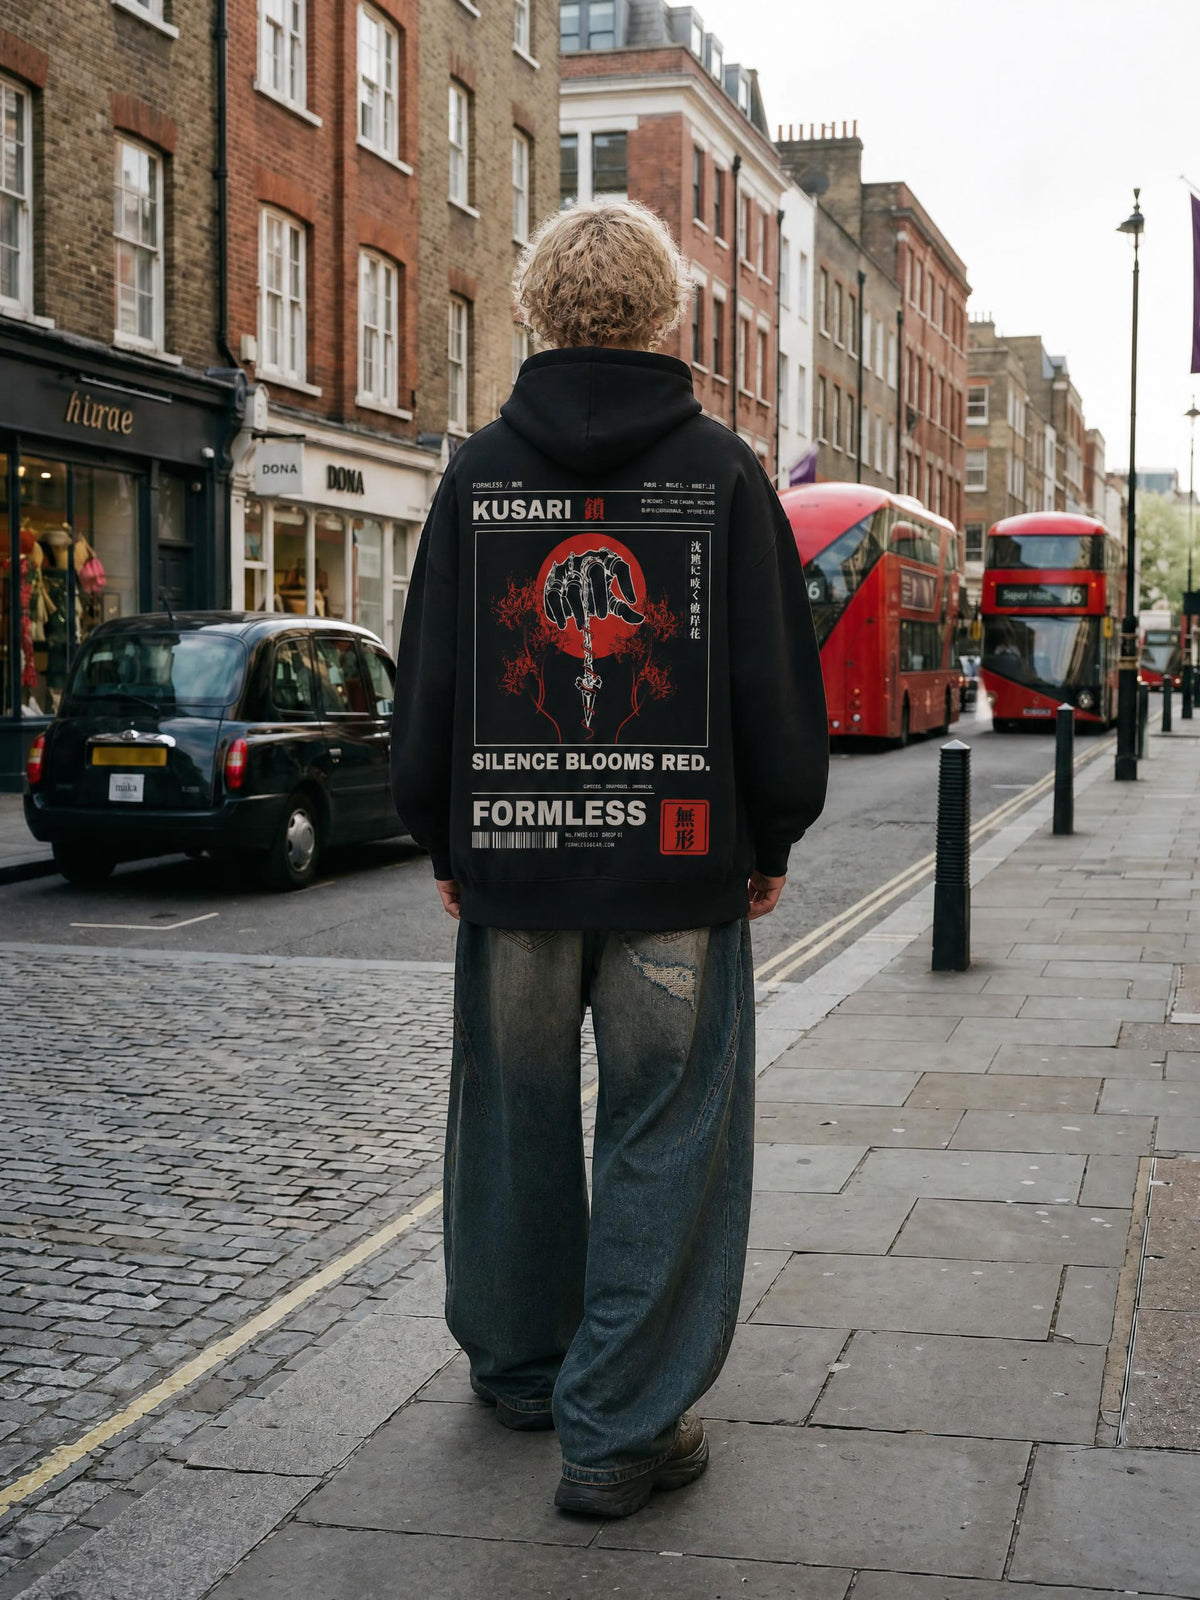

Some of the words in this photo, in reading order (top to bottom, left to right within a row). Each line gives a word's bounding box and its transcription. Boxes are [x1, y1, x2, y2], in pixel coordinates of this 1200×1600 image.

[262, 464, 298, 475] DONA
[326, 464, 365, 495] DONA
[472, 481, 503, 489] FORMLESS
[472, 499, 571, 521] KUSARI
[471, 752, 559, 771] SILENCE
[565, 752, 655, 771] BLOOMS
[661, 753, 711, 772] RED.
[473, 799, 647, 827] FORMLESS
[674, 805, 695, 850] 無形
